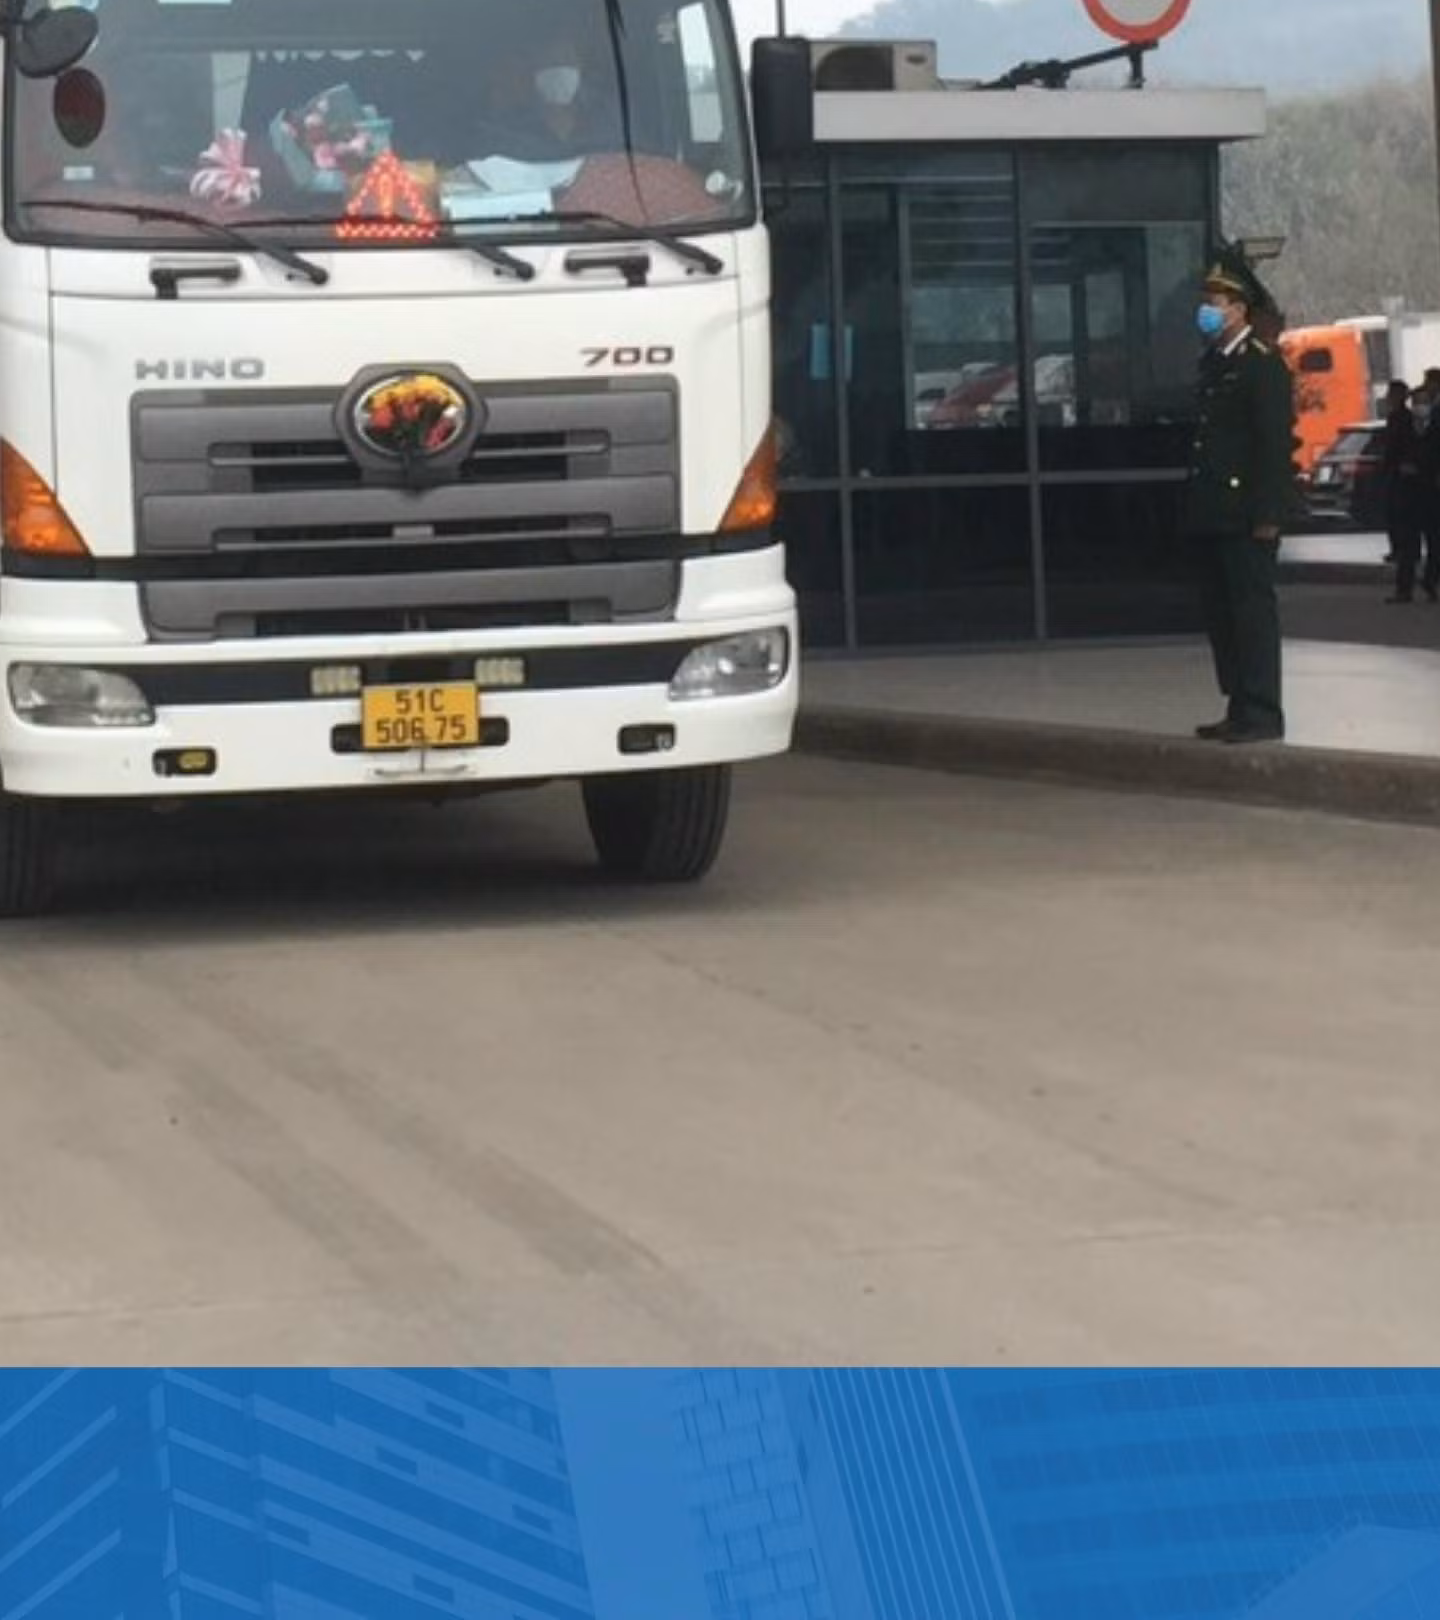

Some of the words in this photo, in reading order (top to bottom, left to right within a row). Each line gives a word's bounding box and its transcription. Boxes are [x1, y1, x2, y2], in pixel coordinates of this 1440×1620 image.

[579, 346, 675, 367] 700
[135, 357, 266, 380] HINO
[394, 689, 445, 714] 51C
